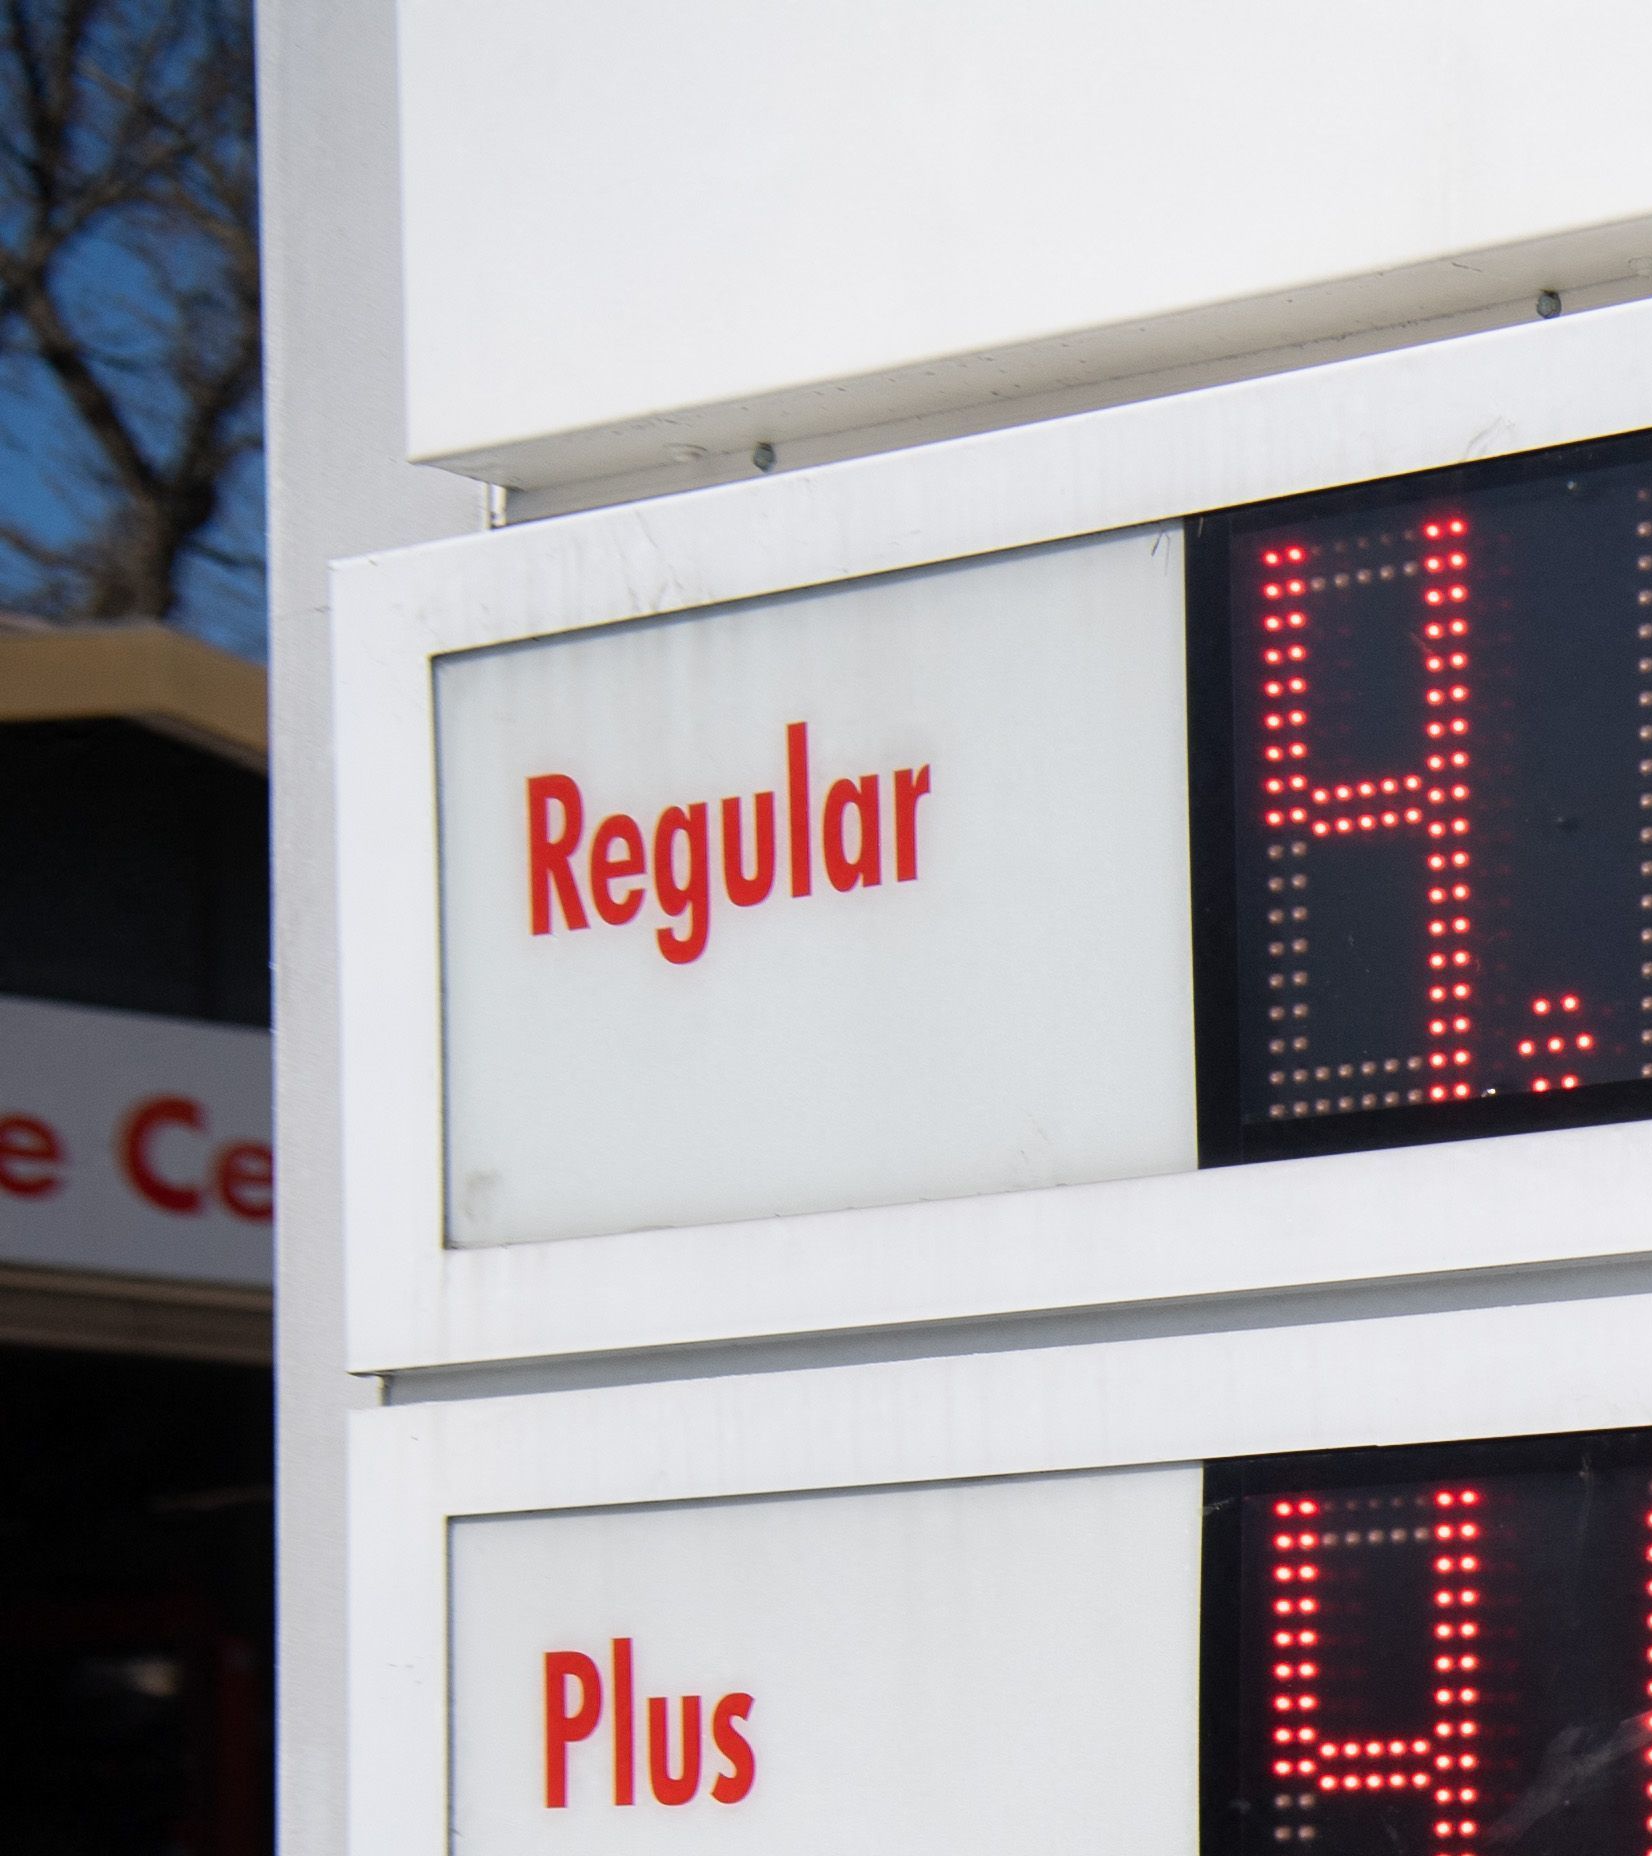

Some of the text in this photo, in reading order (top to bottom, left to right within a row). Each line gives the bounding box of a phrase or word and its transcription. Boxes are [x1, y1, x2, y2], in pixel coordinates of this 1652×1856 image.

[526, 721, 931, 965] Regular
[113, 1094, 273, 1221] Ce
[543, 1637, 756, 1809] Plus
